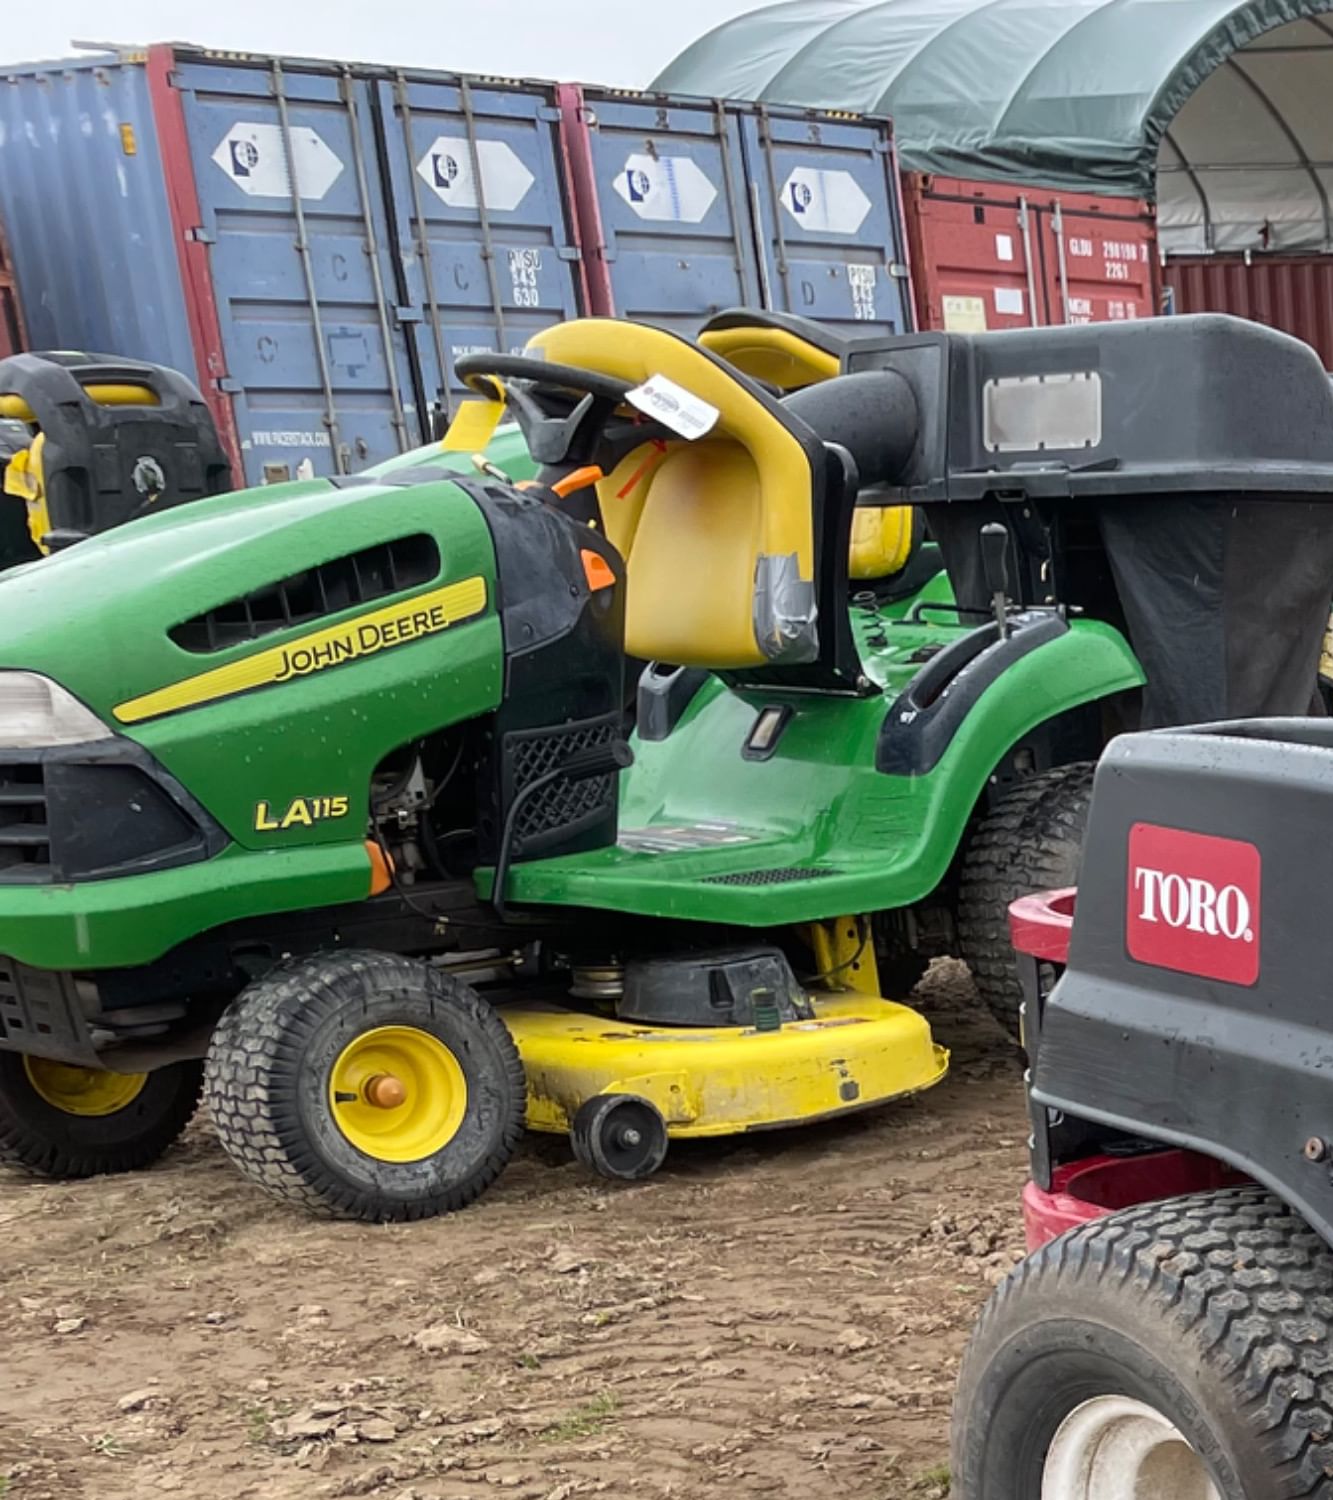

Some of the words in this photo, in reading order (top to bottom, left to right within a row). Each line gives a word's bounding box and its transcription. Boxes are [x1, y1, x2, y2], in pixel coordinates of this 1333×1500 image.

[275, 635, 355, 679] JOHN
[357, 604, 447, 650] DEERE
[255, 796, 349, 831] LA115
[1134, 866, 1250, 940] TORO
